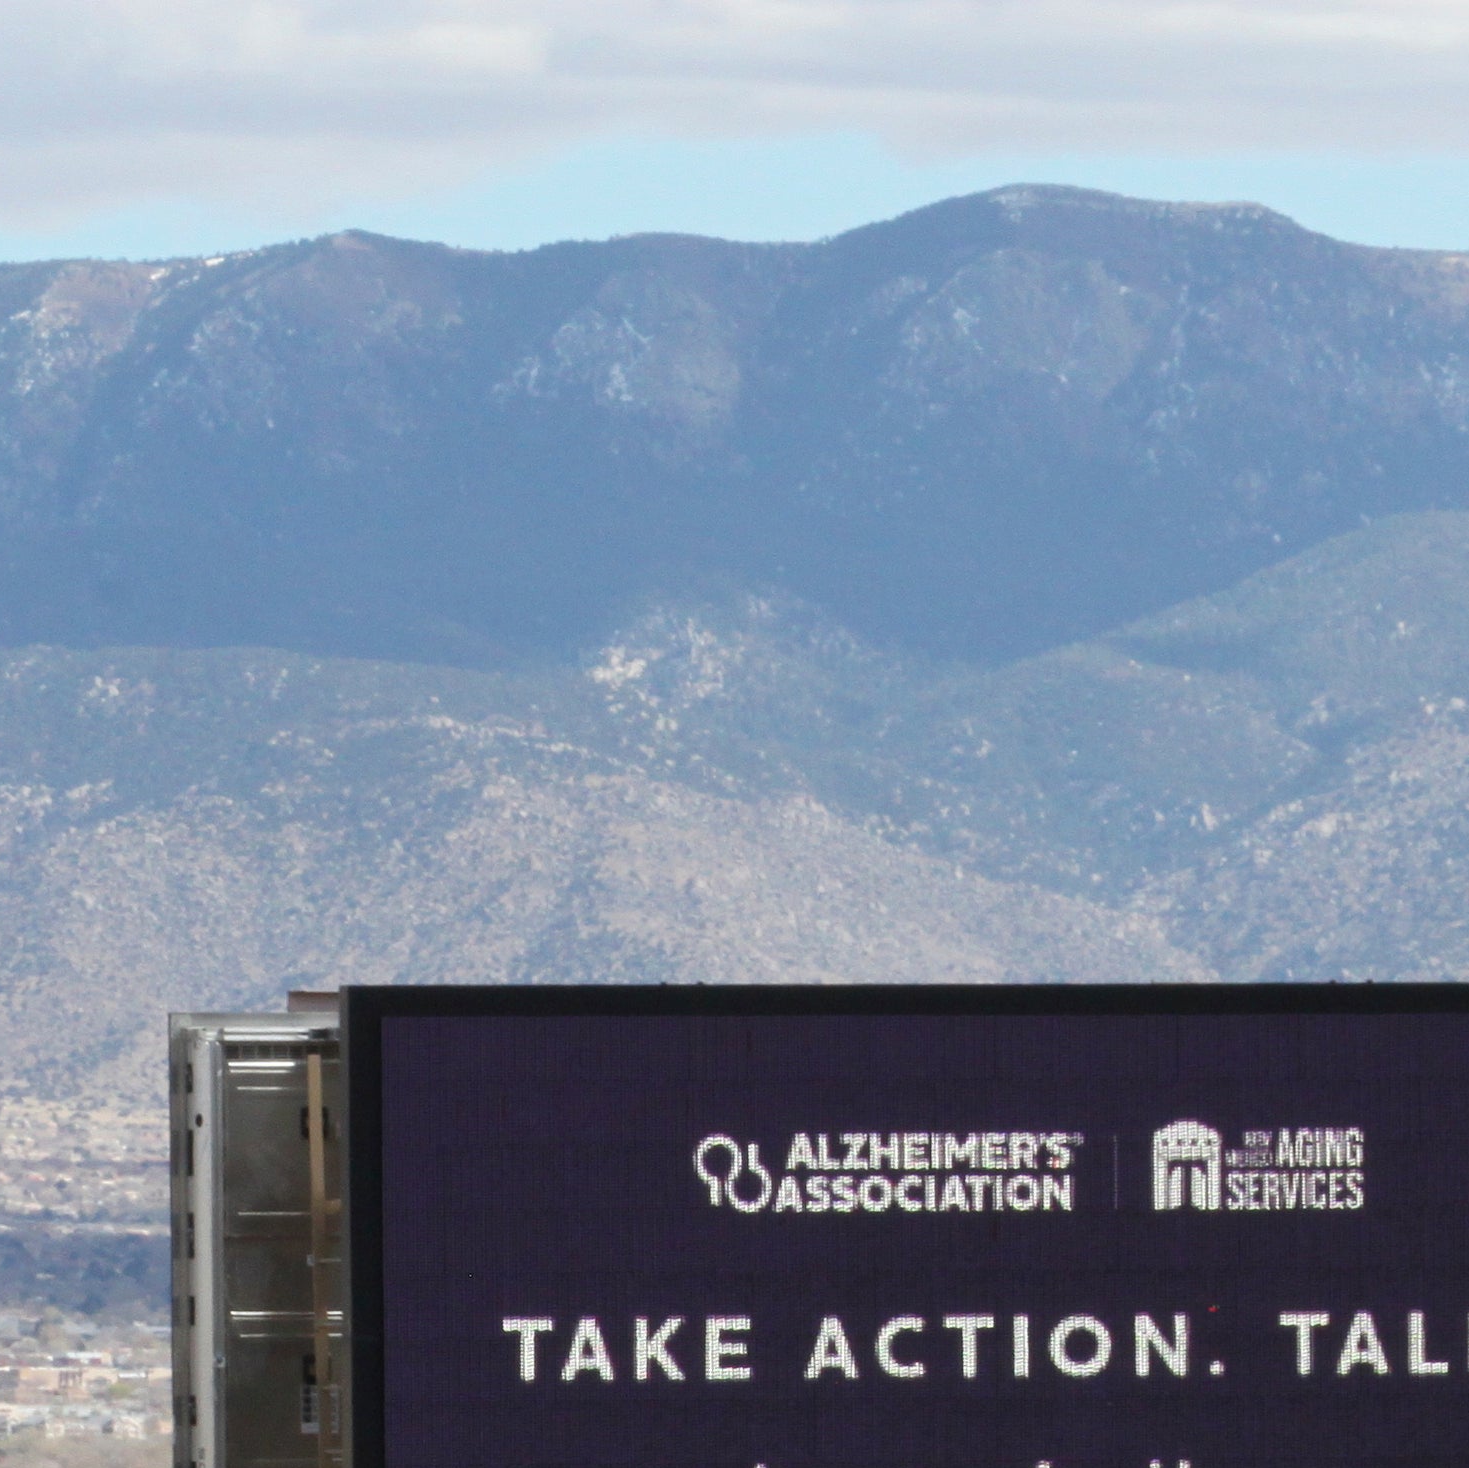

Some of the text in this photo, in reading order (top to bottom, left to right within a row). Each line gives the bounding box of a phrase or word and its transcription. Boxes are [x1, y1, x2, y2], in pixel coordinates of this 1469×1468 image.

[786, 1131, 1075, 1171] ALZHEIMER'S
[1276, 1127, 1365, 1168] AGING
[772, 1174, 1073, 1213] ASSOCIATION
[1225, 1170, 1365, 1210] SERVICES
[502, 1317, 751, 1382] TAKE
[804, 1315, 1225, 1379] ACTION.
